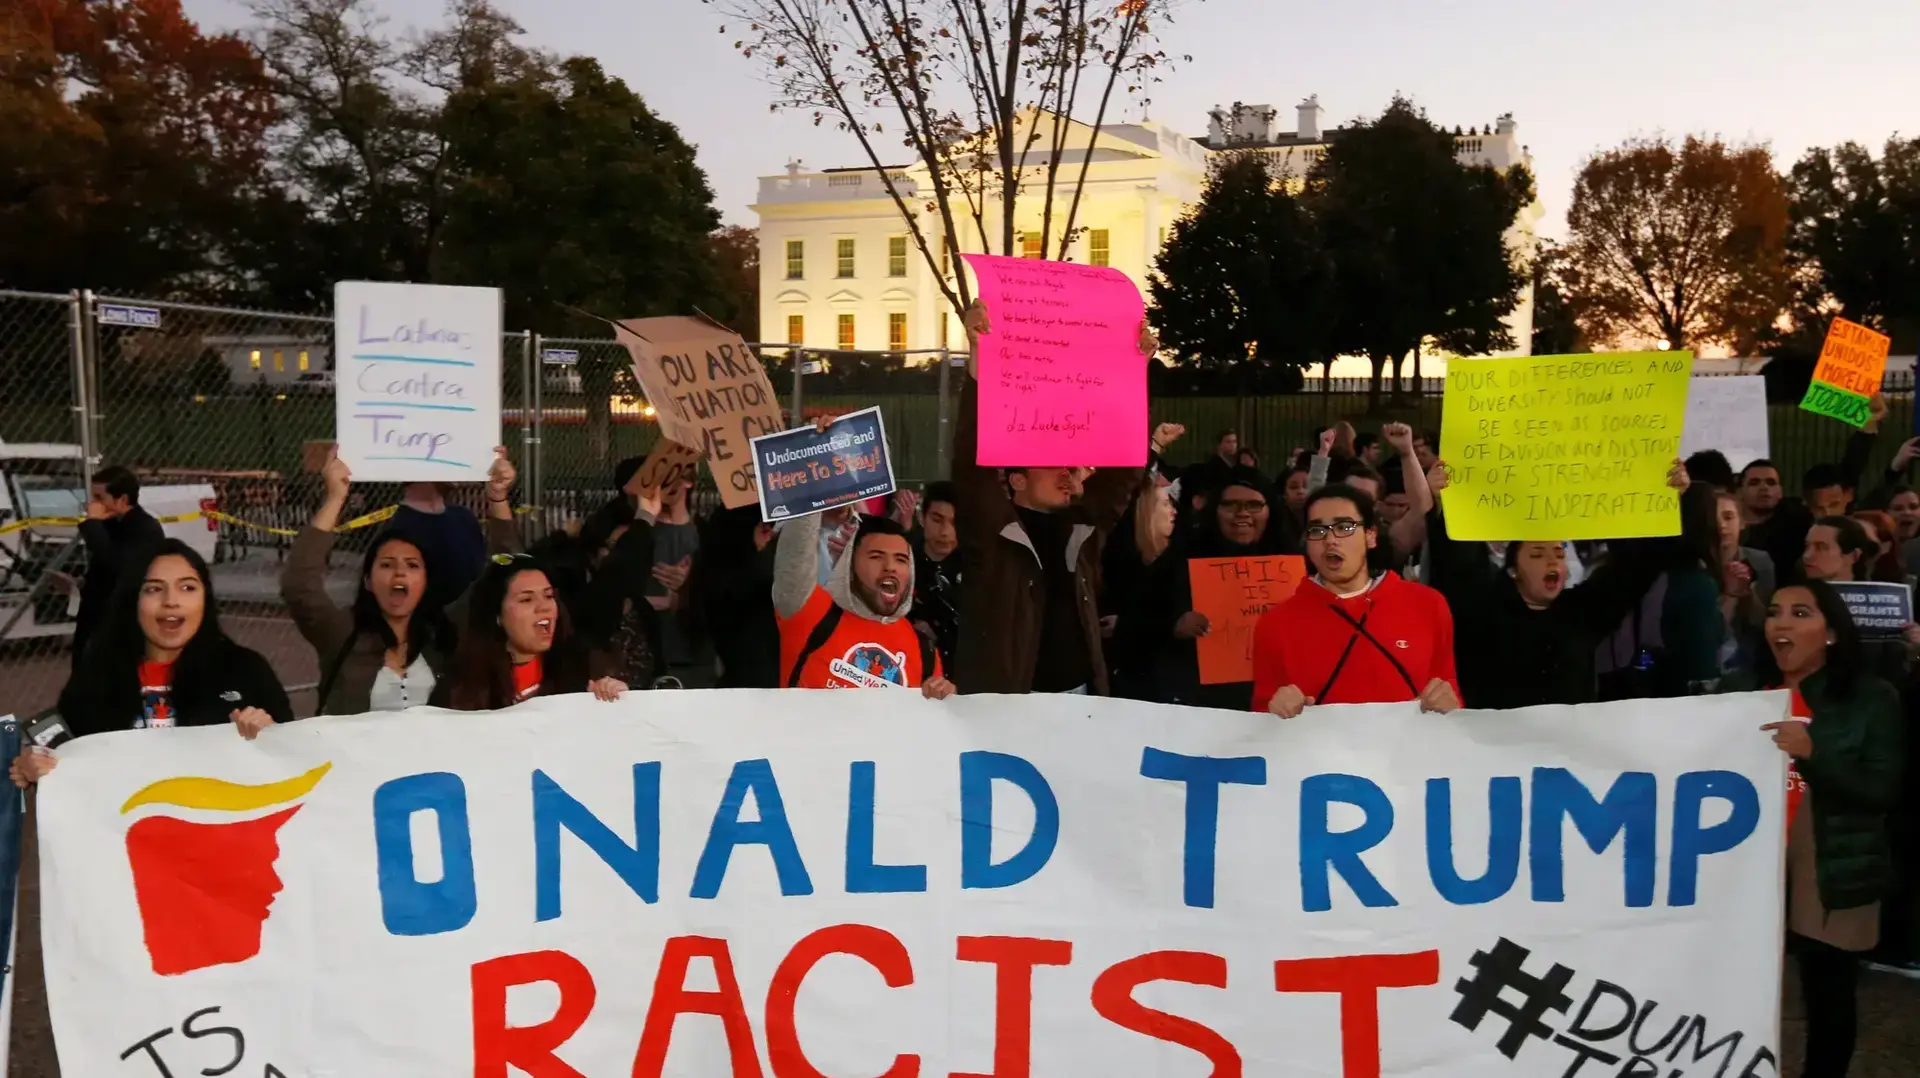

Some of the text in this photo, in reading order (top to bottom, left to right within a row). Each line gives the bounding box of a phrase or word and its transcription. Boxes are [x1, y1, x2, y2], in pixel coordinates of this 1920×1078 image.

[657, 343, 757, 387] OU ARE
[1647, 360, 1684, 374] AND
[357, 363, 466, 399] Contra
[1623, 383, 1655, 400] NOT
[353, 414, 453, 460] Trump
[1478, 419, 1500, 439] BE
[1601, 415, 1667, 432] SOURCES
[765, 426, 876, 466] Undocumented and
[1463, 443, 1491, 461] OF
[768, 445, 880, 490] Here To Stay!
[1443, 460, 1633, 488] BUT OF STRENGTH
[1476, 492, 1678, 522] AND INSPIRATION
[1208, 559, 1291, 583] THIS
[1242, 585, 1271, 599] IS
[1848, 605, 1902, 616] GRANTS
[833, 662, 863, 683] United
[1140, 746, 1761, 912] TRUMP
[471, 924, 1440, 1078] RACIST
